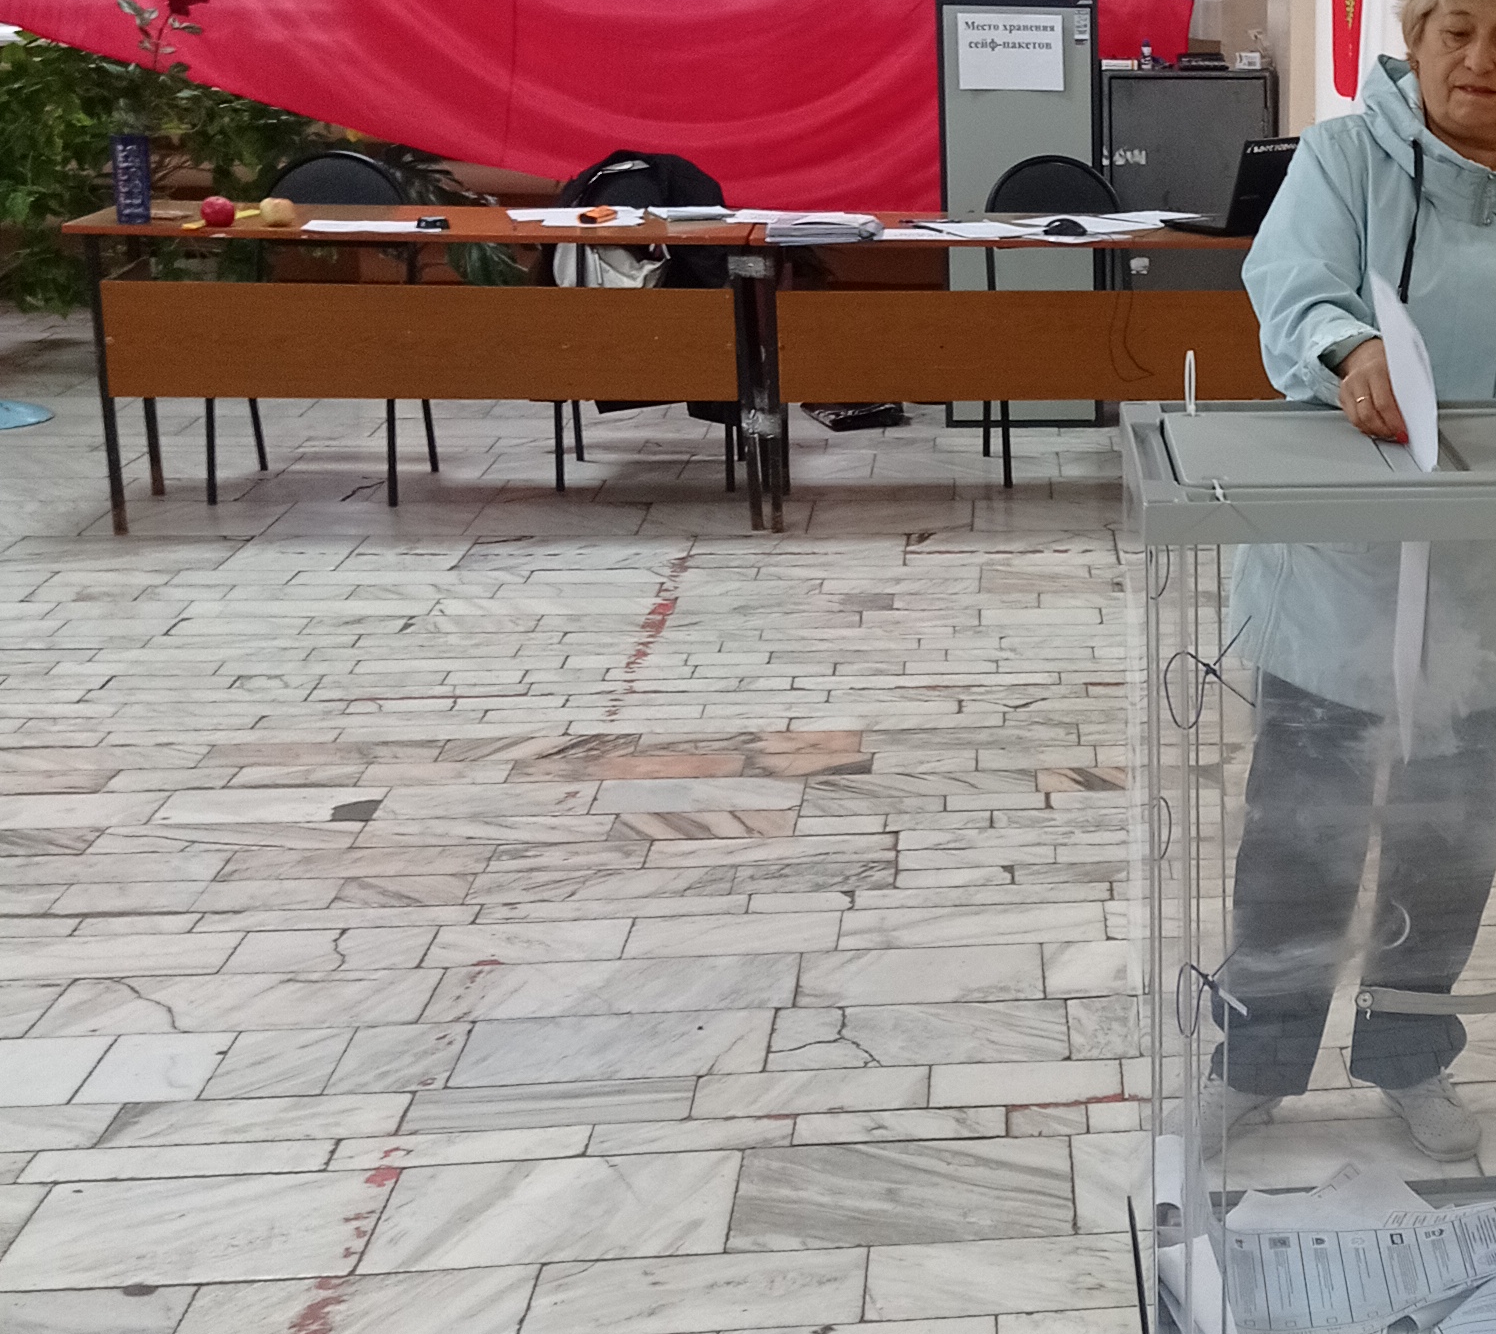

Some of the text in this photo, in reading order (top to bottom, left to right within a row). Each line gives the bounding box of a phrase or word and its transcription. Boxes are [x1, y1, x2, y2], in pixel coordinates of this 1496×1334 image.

[964, 21, 1055, 33] Место хранения
[969, 39, 1052, 51] сейф-пакетов
